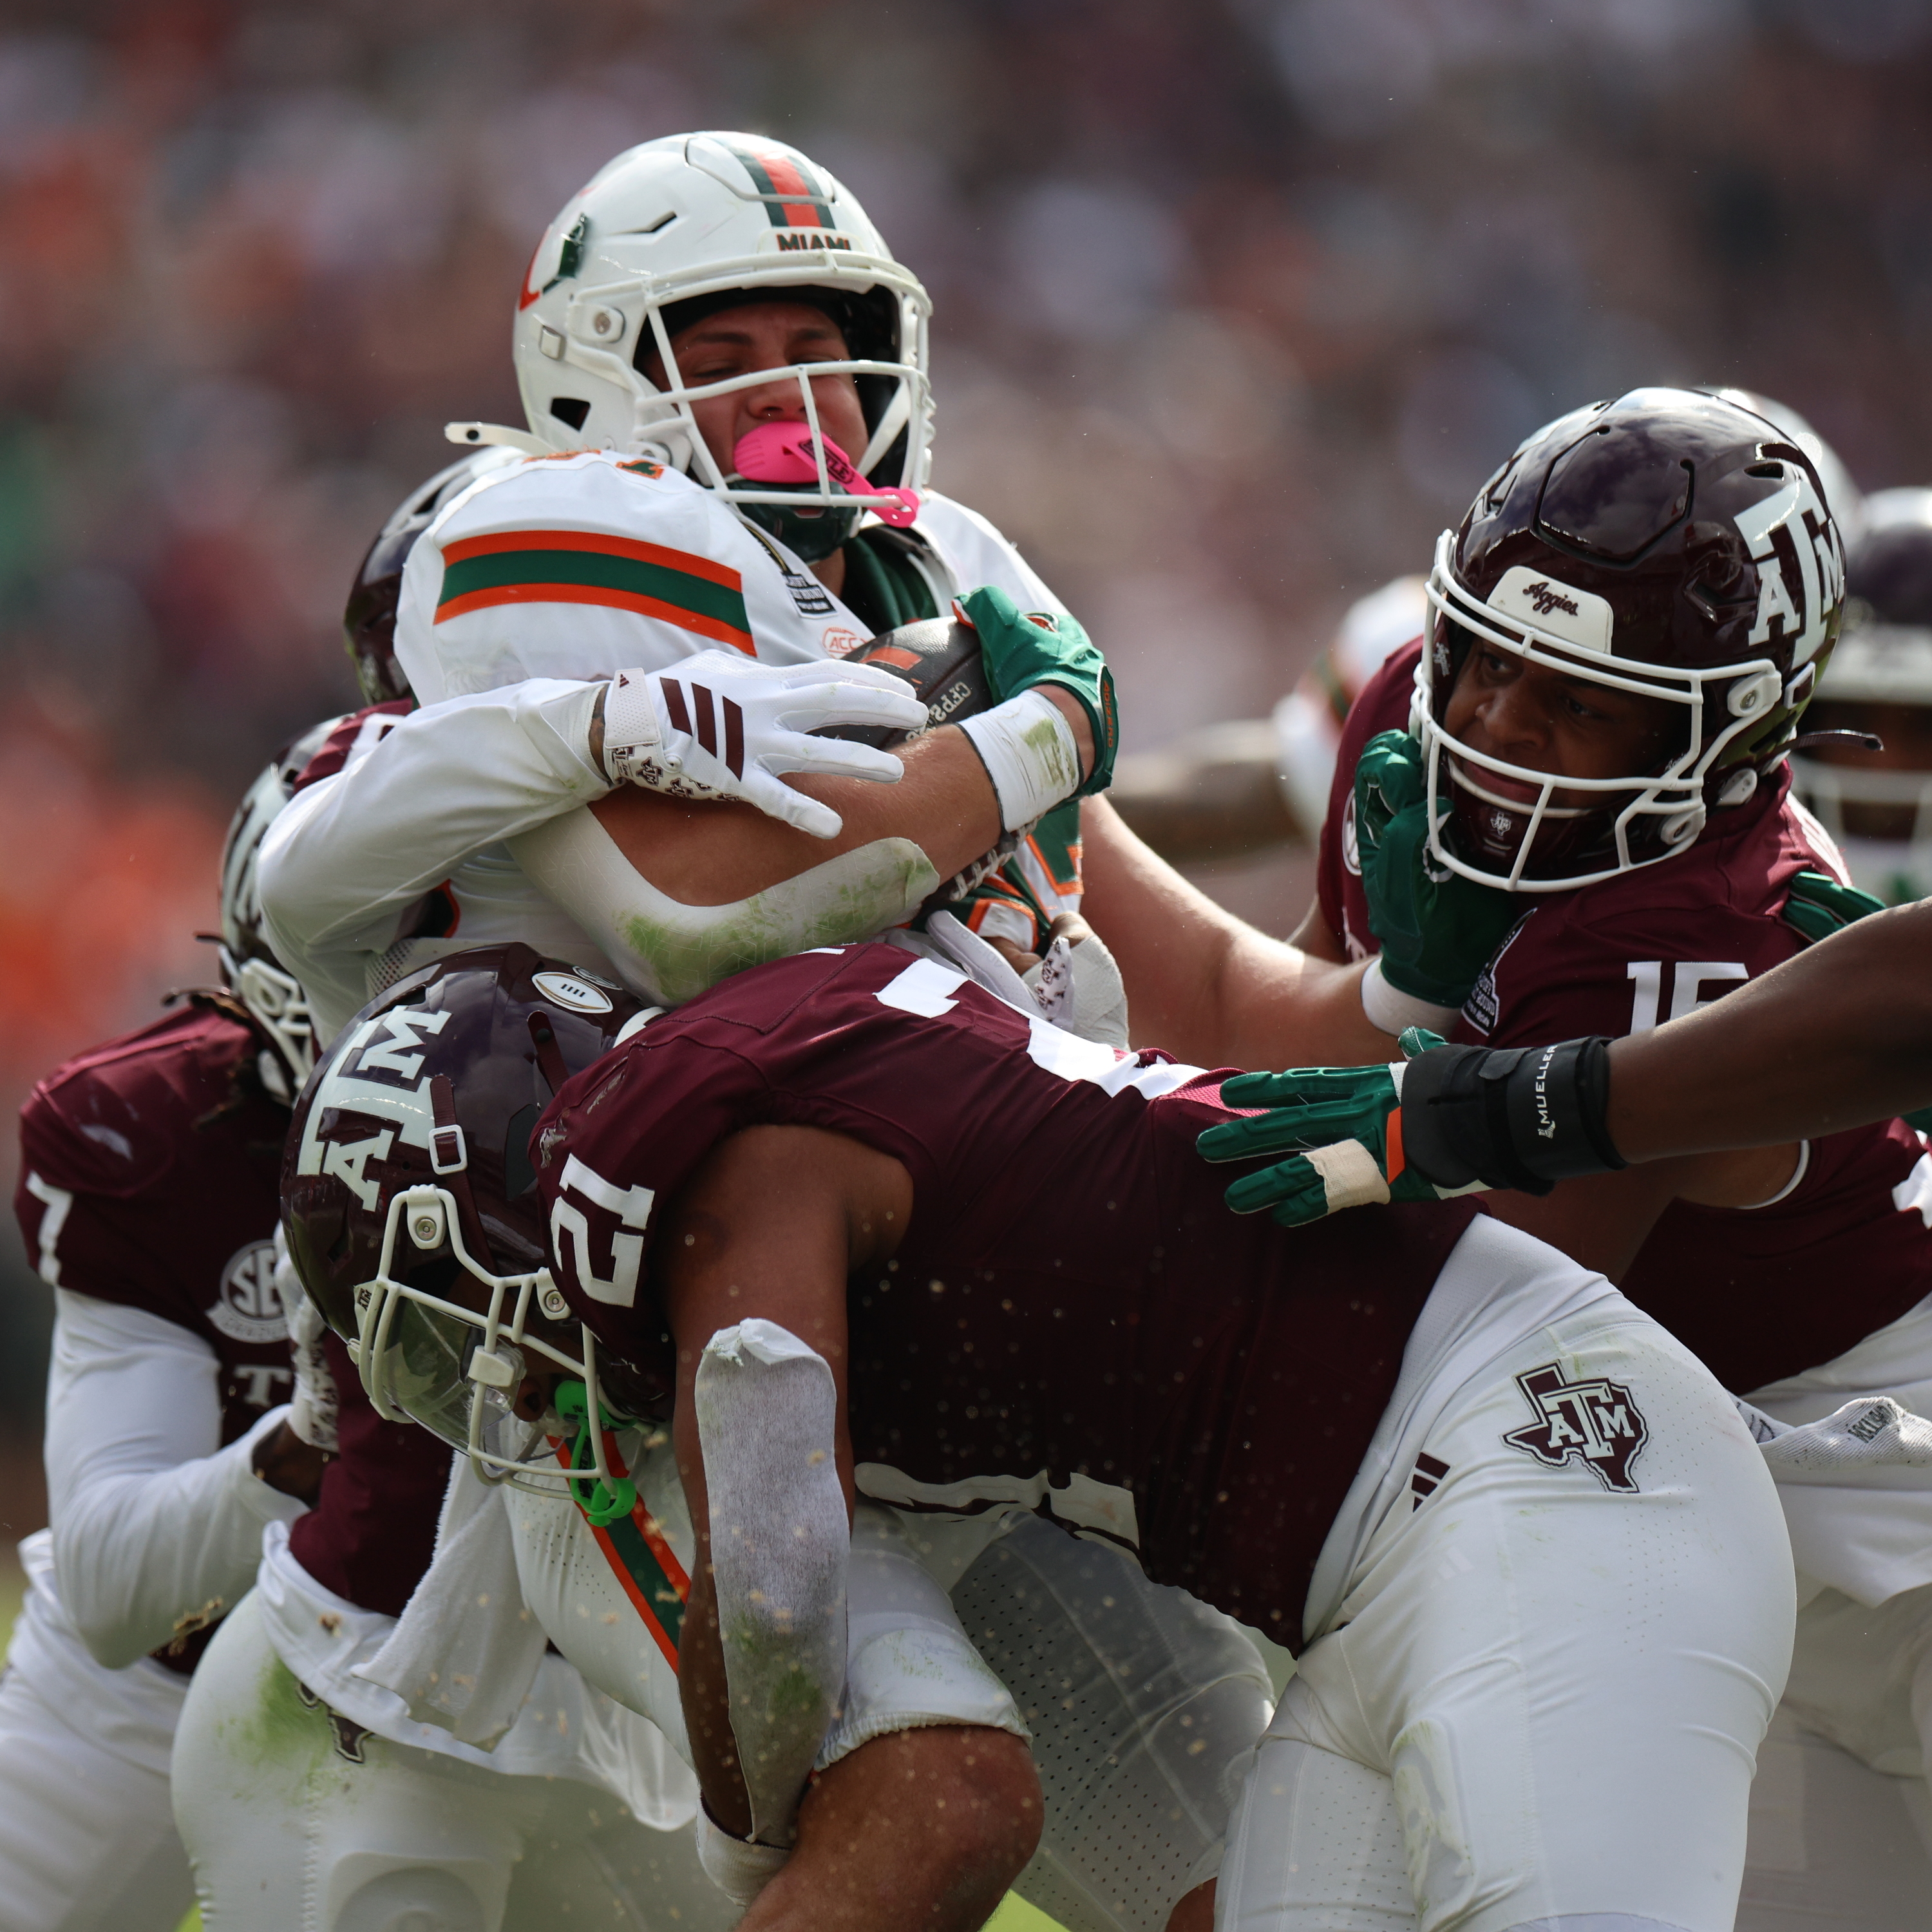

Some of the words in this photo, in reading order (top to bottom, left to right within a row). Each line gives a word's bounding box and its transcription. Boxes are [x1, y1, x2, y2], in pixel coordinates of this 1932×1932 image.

[776, 232, 851, 252] MIAMI
[1522, 582, 1578, 616] Aggies
[829, 636, 858, 650] ACC
[1535, 1045, 1558, 1124] MUELLER
[550, 1152, 655, 1308] 21
[230, 1247, 283, 1316] SE
